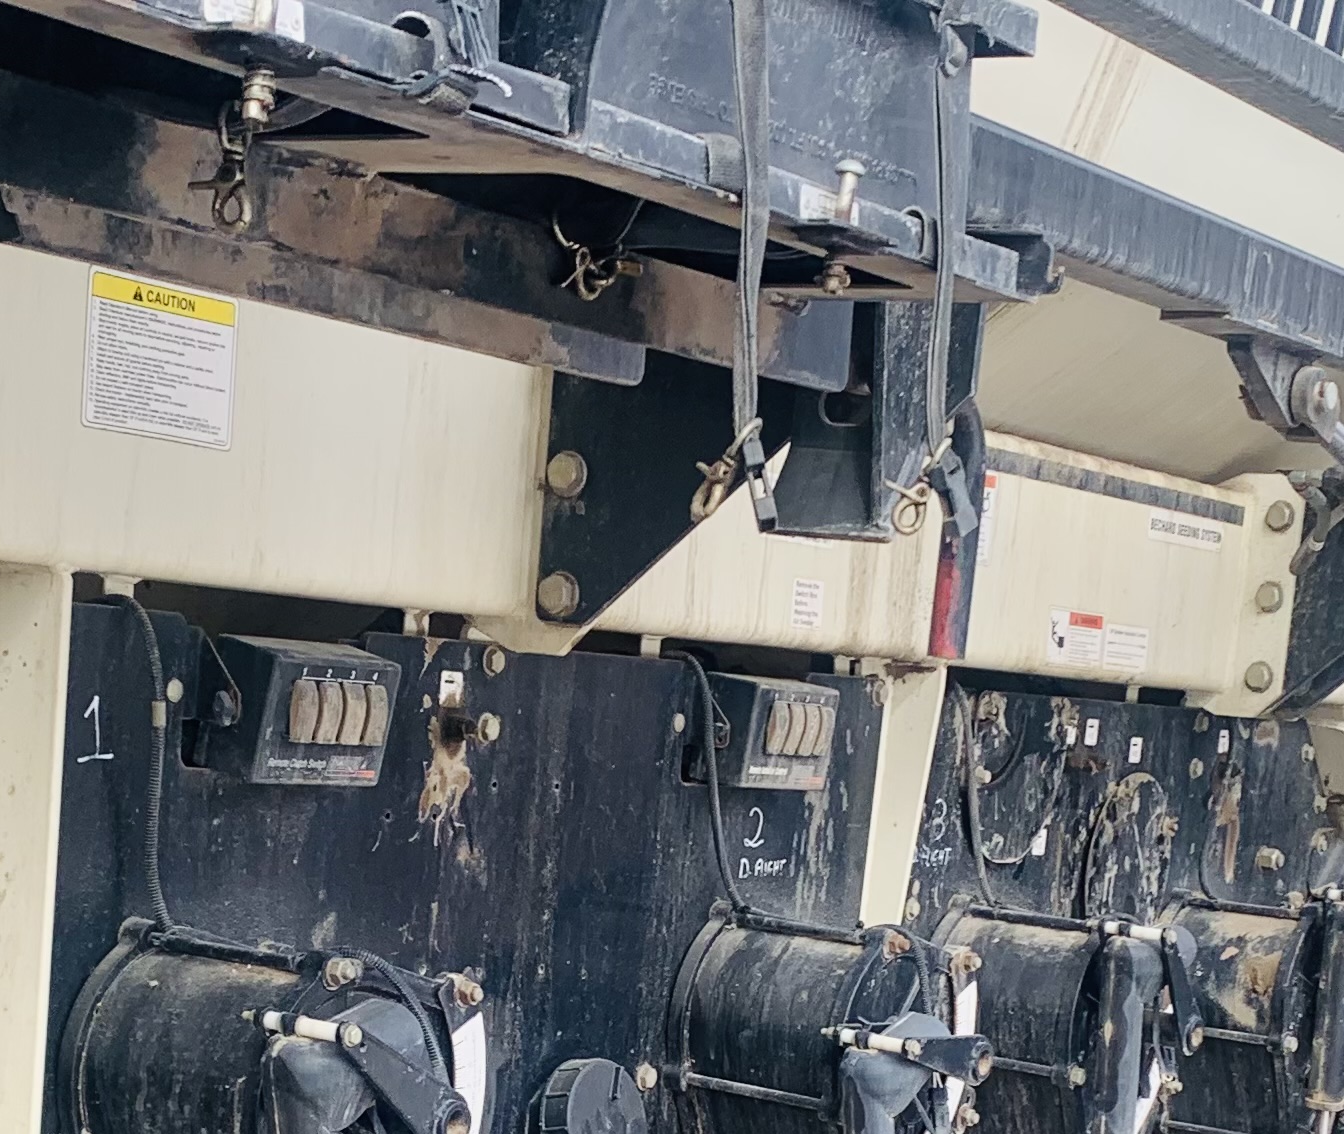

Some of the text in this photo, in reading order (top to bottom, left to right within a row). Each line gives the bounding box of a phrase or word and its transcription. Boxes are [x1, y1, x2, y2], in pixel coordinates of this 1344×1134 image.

[146, 291, 196, 312] CAUTION
[77, 696, 115, 763] 1
[743, 807, 765, 848] 2
[931, 798, 947, 841] 3
